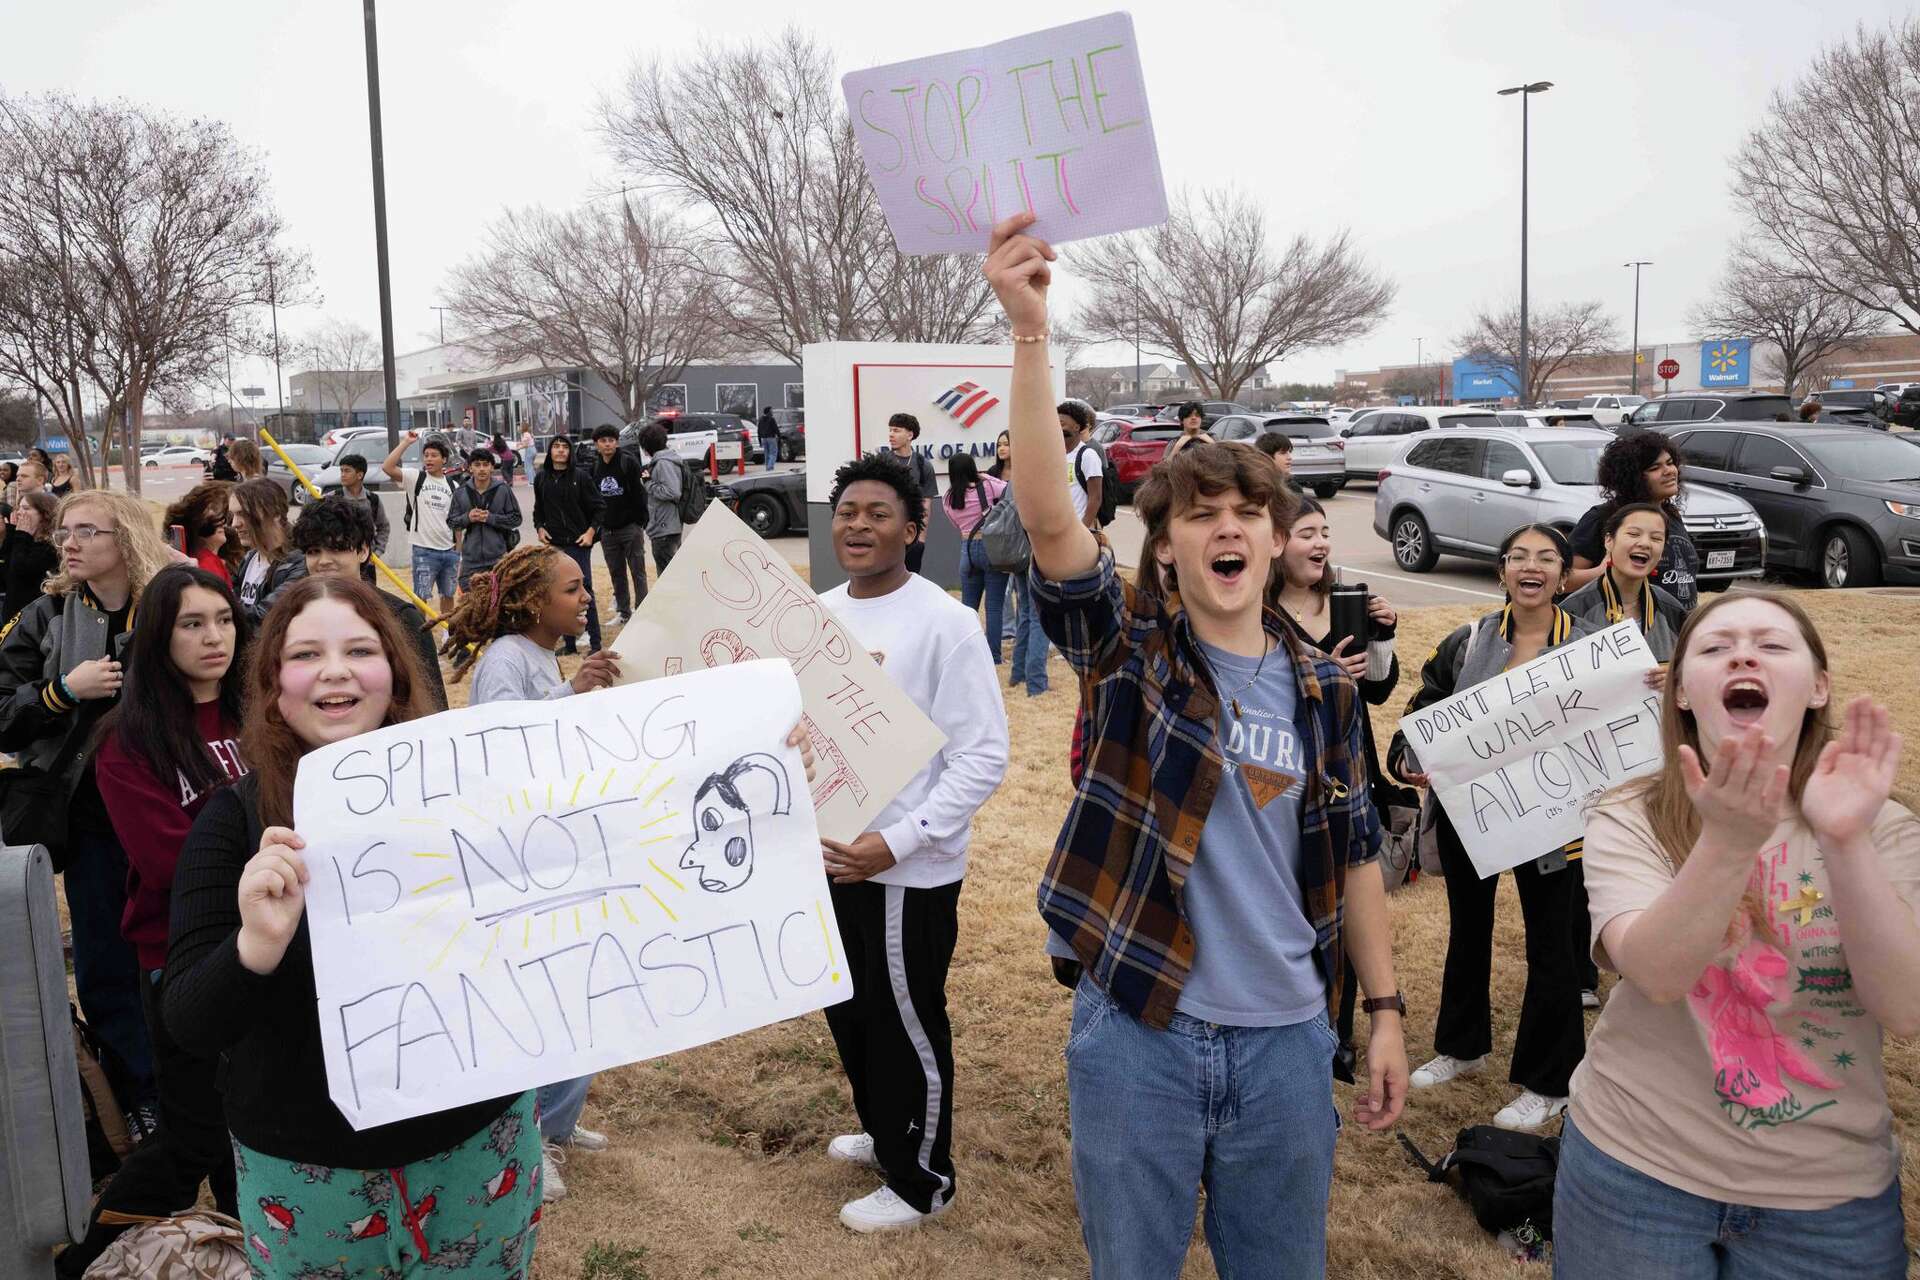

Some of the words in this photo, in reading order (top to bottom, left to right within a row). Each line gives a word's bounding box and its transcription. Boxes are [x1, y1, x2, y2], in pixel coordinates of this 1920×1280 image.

[859, 69, 988, 172] STOP
[1007, 44, 1143, 146] THE
[1658, 364, 1679, 374] STOP
[1708, 373, 1739, 381] Walmart
[701, 539, 851, 676] STOP
[827, 674, 890, 746] THE
[1415, 686, 1490, 744] DON'T
[1506, 649, 1576, 705] LET
[1591, 626, 1641, 669] ME
[1467, 689, 1599, 760] WALK
[333, 695, 697, 815] SPLITTING
[332, 842, 402, 925] IS
[451, 797, 639, 908] NOT
[340, 900, 841, 1111] FANTASTIC!
[1801, 943, 1842, 960] WITHOU
